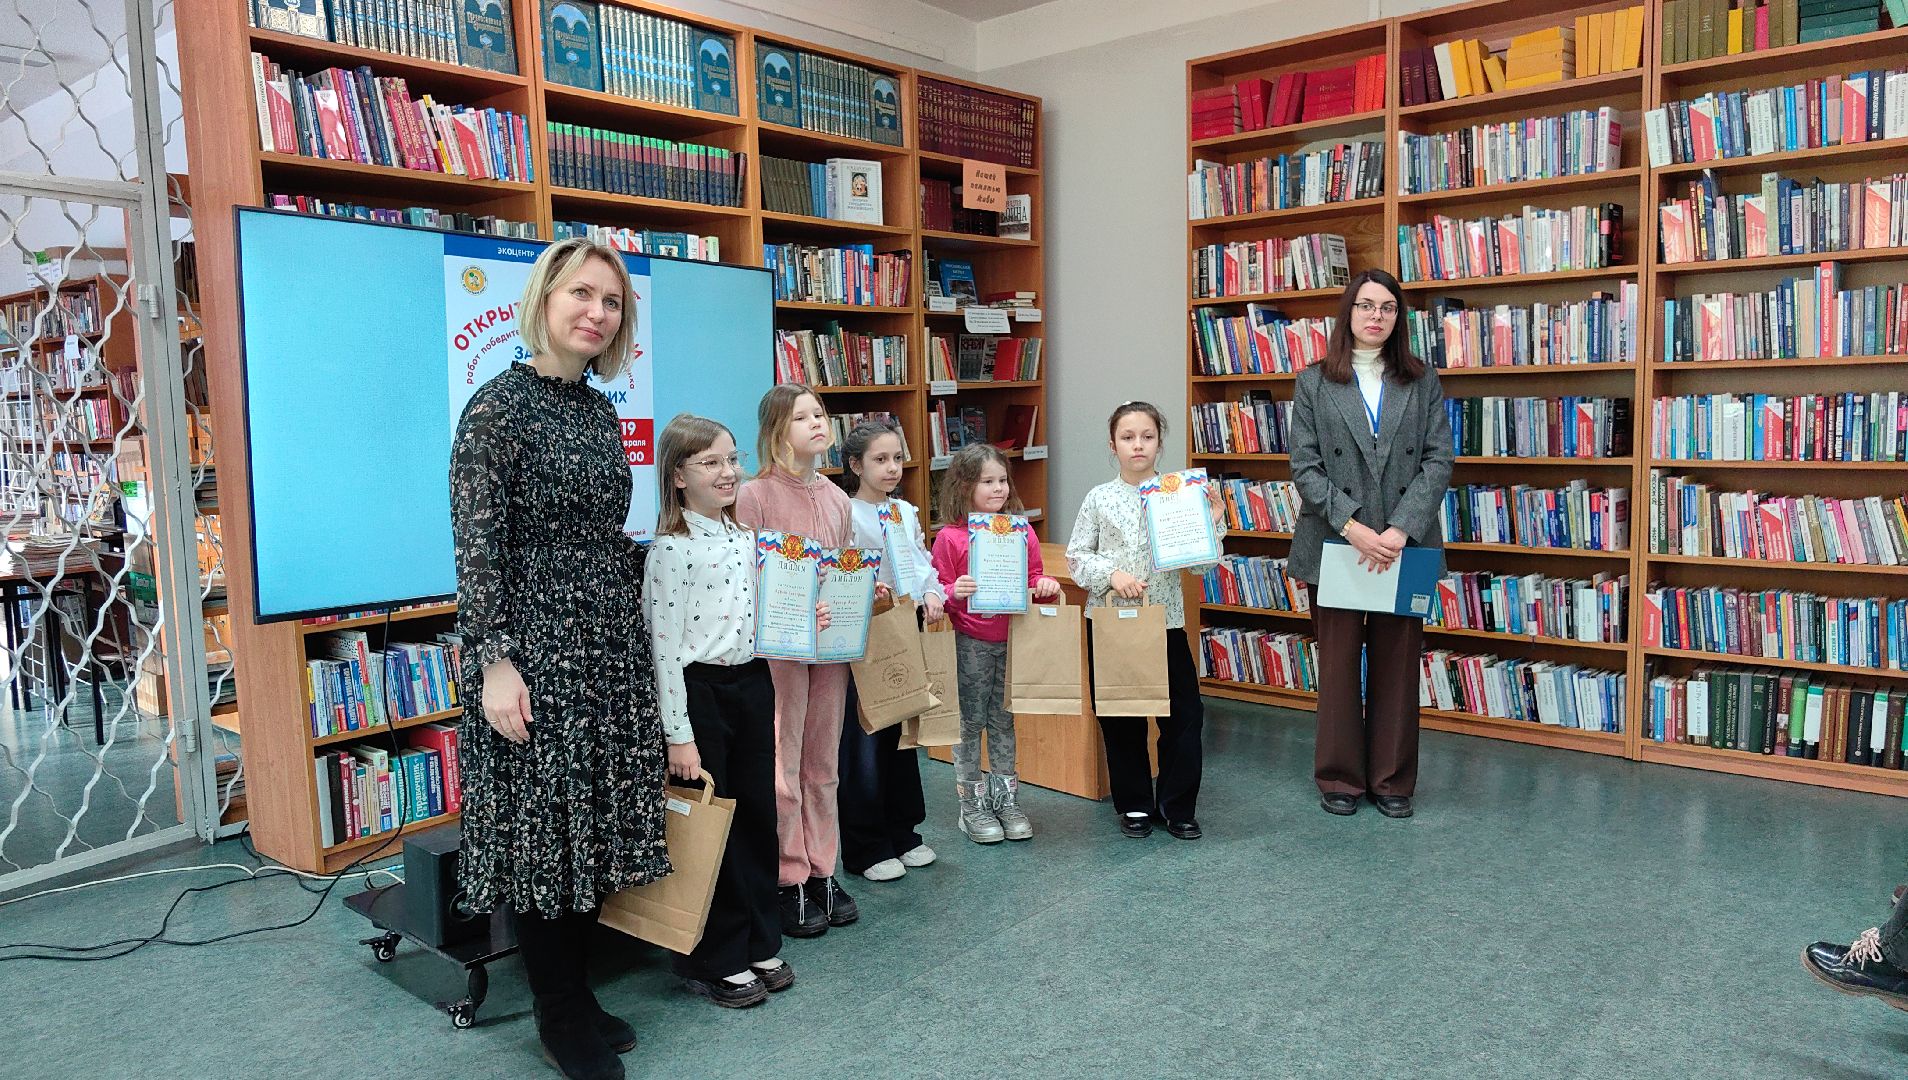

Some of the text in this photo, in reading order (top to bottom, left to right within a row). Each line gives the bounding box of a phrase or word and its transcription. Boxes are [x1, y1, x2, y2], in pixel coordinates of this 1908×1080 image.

[497, 247, 535, 258] ЭКОЦЕНТР
[454, 301, 521, 351] ОТКРЫ
[466, 353, 481, 385] работ
[621, 421, 636, 436] 19
[413, 763, 425, 818] Справочник
